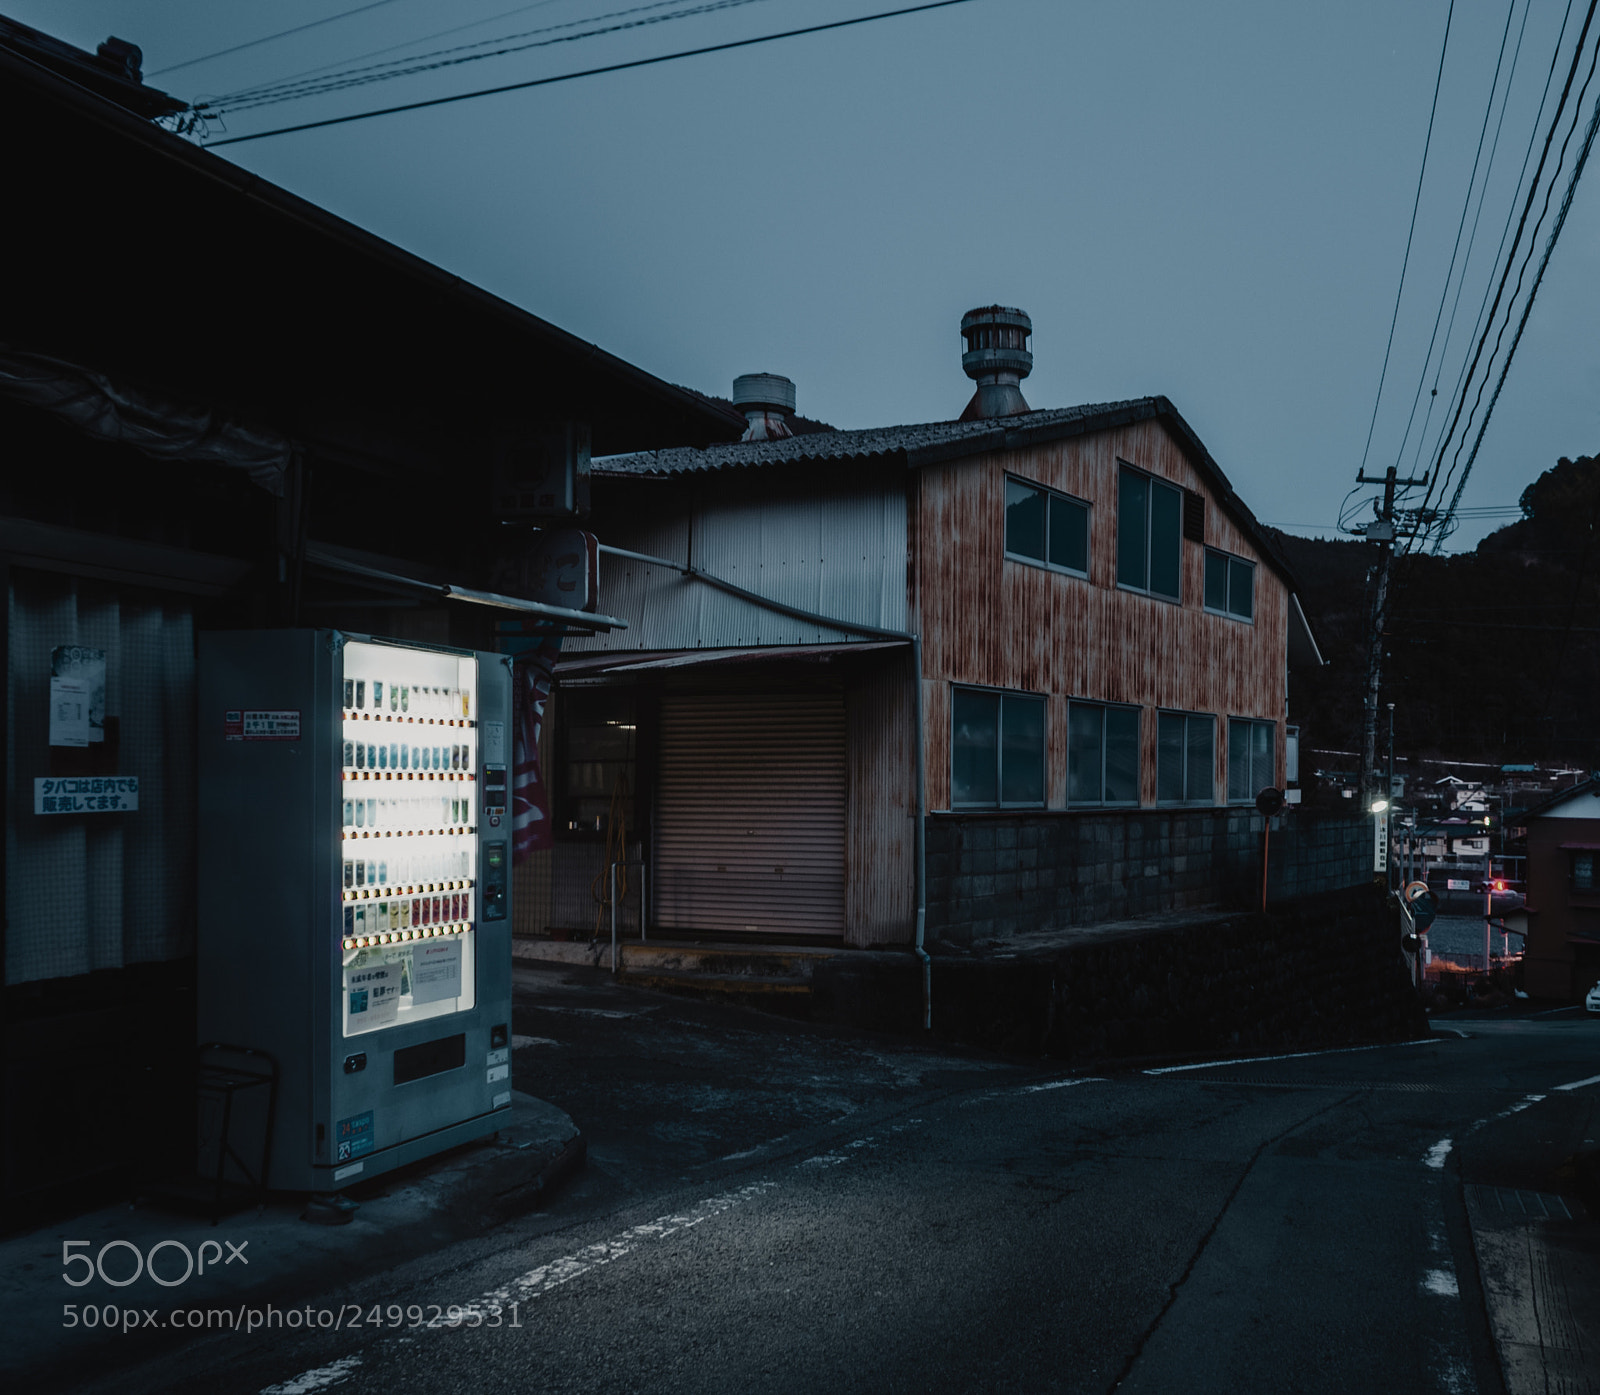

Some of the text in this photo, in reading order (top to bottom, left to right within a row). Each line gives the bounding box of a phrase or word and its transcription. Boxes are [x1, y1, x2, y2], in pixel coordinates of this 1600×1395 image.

[42, 778, 138, 795] タバコは店内でも
[42, 795, 127, 812] 販売してます。
